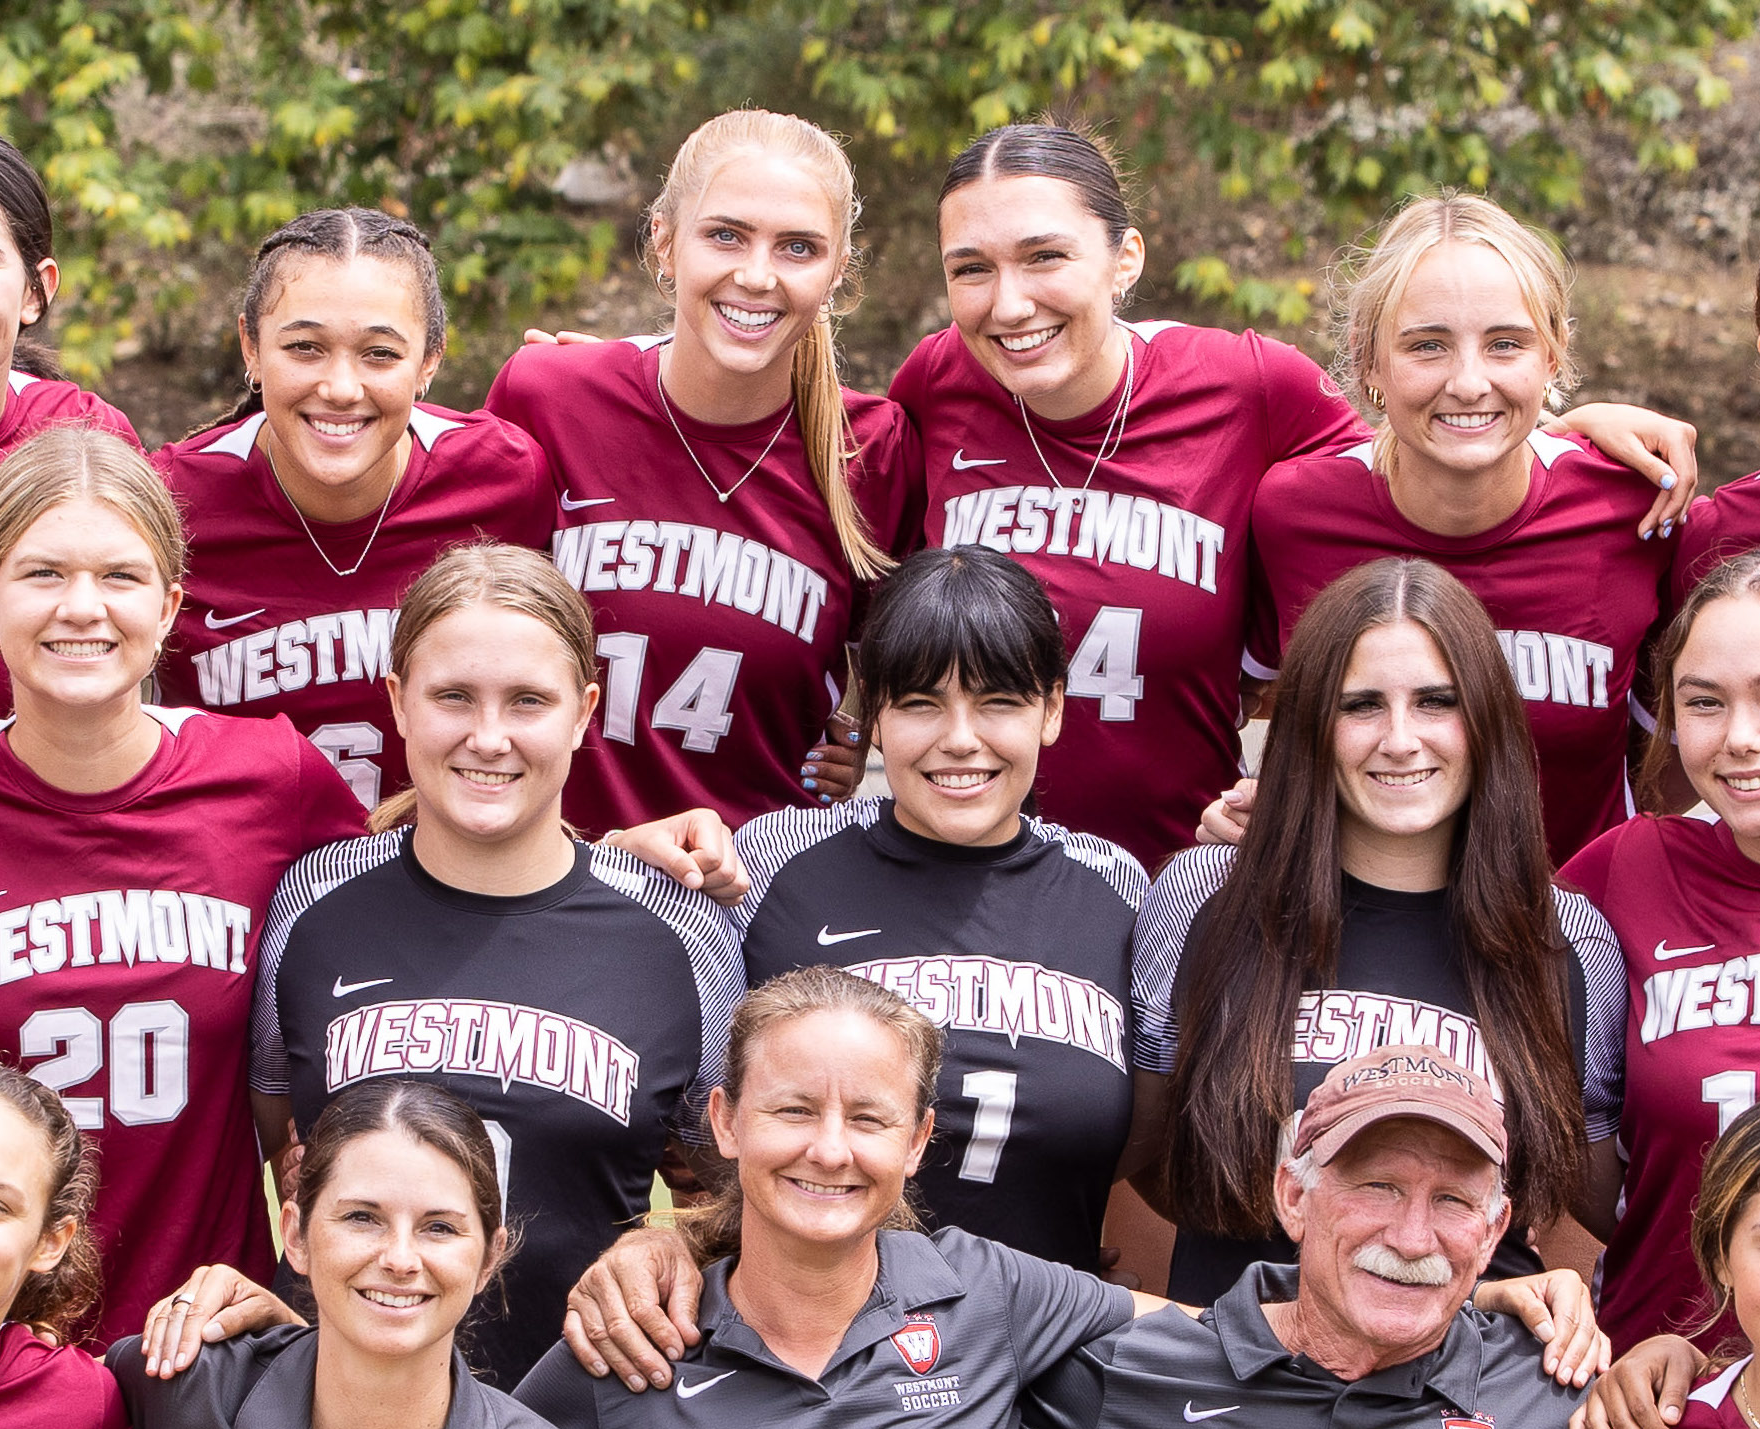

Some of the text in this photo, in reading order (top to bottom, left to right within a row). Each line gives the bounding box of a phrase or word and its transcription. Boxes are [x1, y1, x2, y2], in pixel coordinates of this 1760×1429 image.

[552, 519, 828, 645] WESTMONT
[942, 485, 1225, 595] WESTMONT
[190, 607, 401, 707] WESTM
[595, 631, 744, 754] 14
[1054, 605, 1144, 721] 4
[18, 999, 190, 1130] 20
[324, 997, 641, 1129] WESTMONT
[1343, 1056, 1475, 1097] WESTMONT
[1374, 1077, 1443, 1089] SOCCER
[958, 1068, 1018, 1184] 1
[893, 1375, 960, 1396] WESTMONT
[901, 1390, 962, 1412] SOCCER
